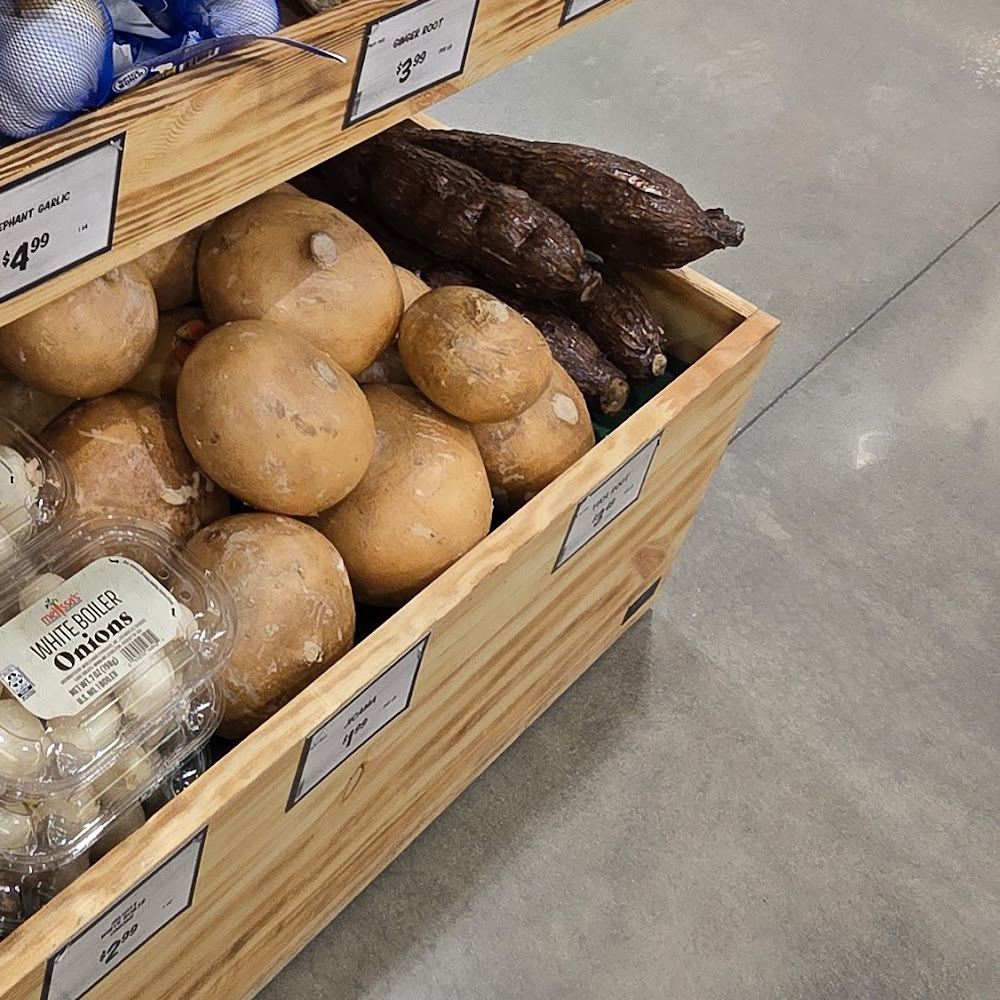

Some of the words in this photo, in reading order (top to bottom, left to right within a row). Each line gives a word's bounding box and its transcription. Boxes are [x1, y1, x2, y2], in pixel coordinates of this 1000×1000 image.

[392, 28, 420, 48] GINGER
[422, 17, 445, 39] ROOT
[38, 191, 71, 214] GARLIC
[41, 592, 82, 626] melissa's
[30, 620, 80, 660] WHITE
[74, 590, 123, 630] BOILER
[54, 611, 133, 672] Onions
[68, 683, 81, 696] NET
[92, 668, 101, 678] OZ
[97, 669, 119, 688] BOILER
